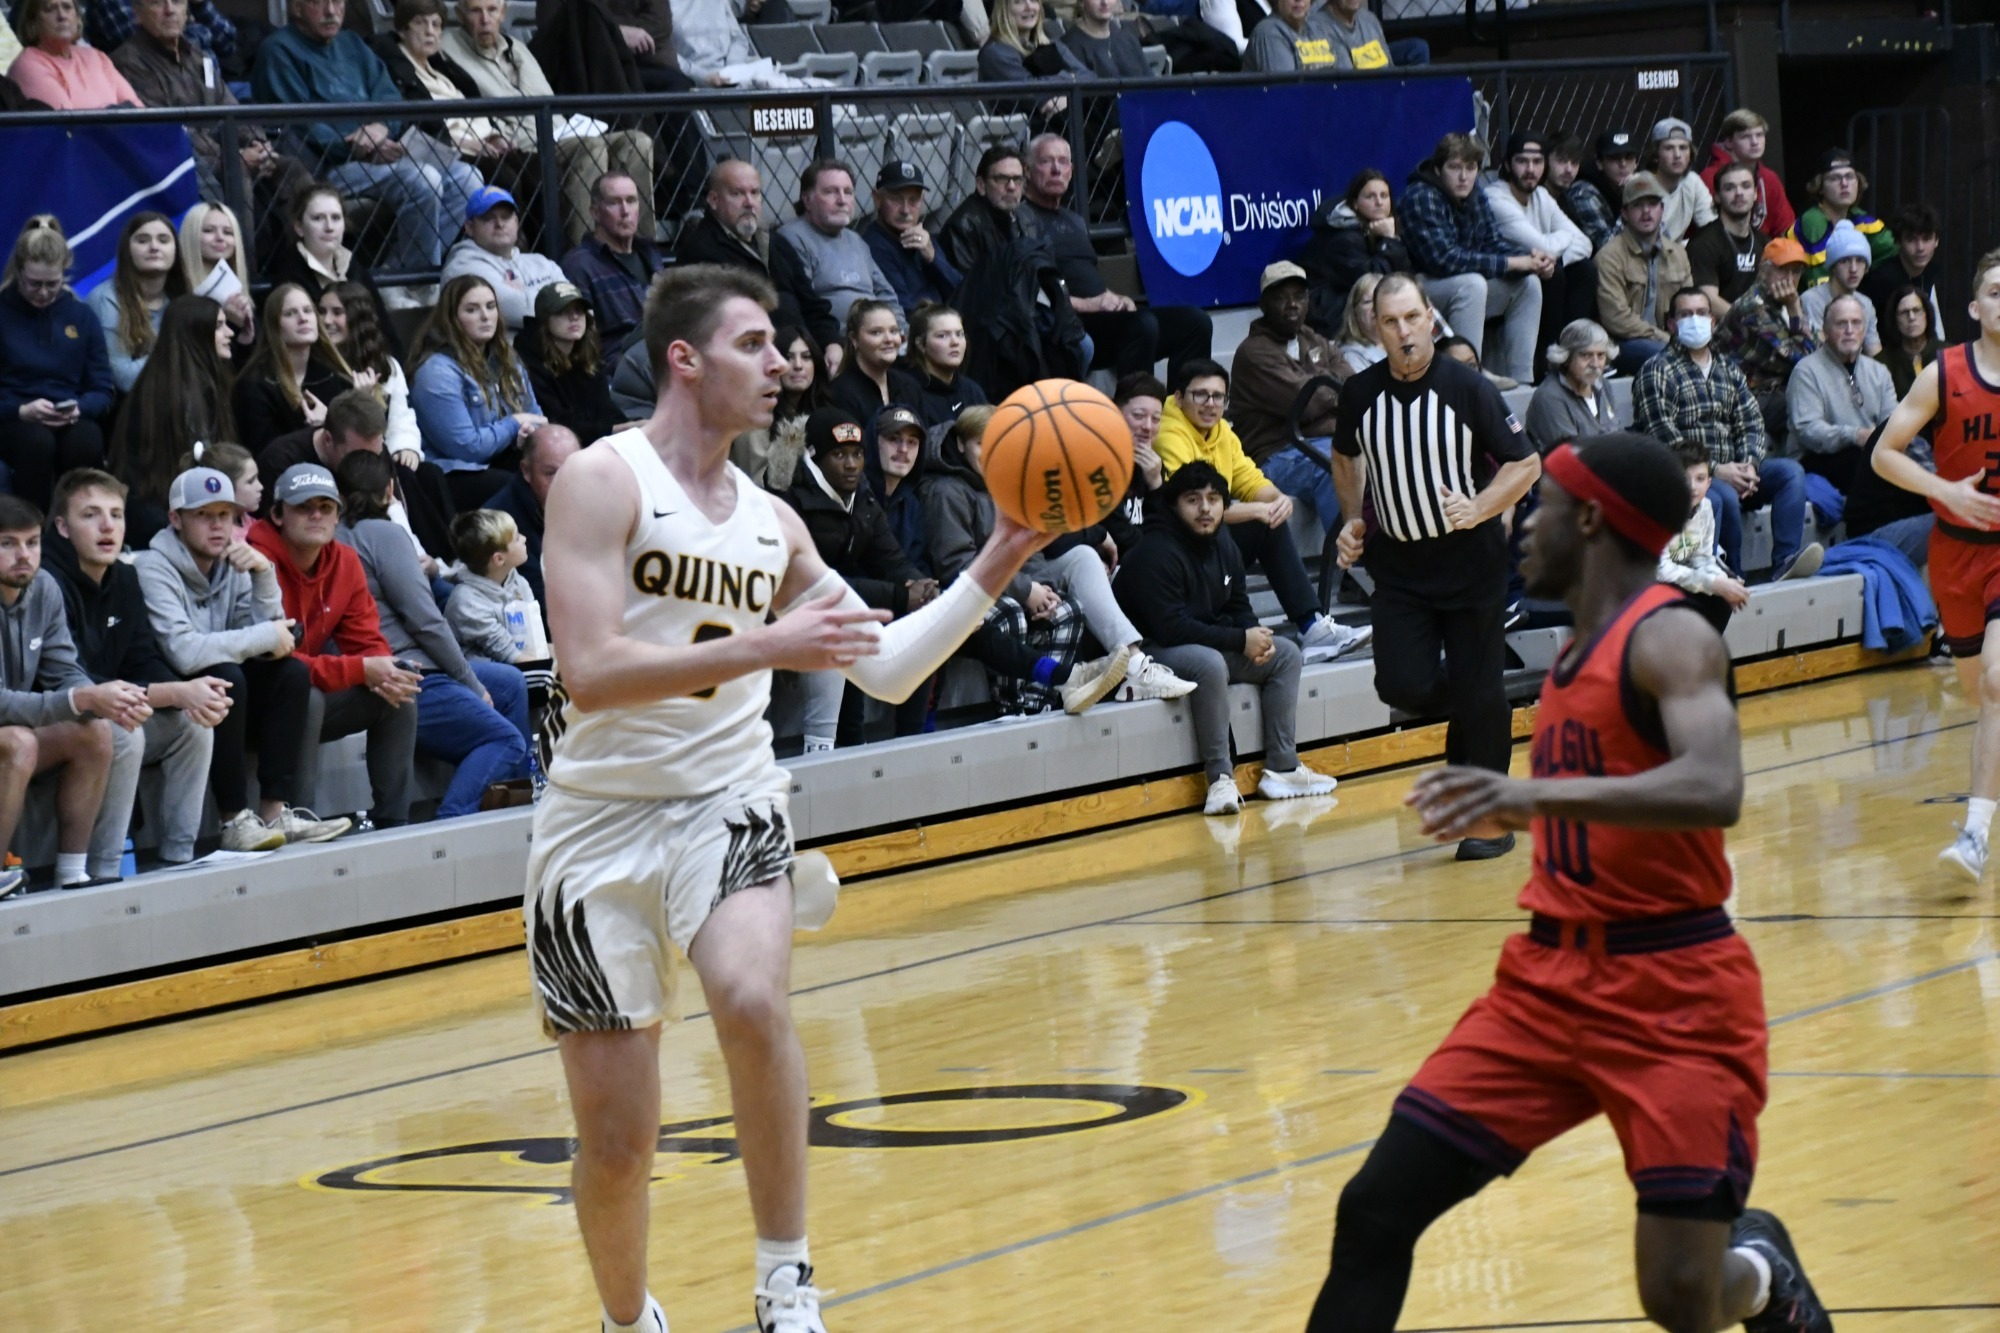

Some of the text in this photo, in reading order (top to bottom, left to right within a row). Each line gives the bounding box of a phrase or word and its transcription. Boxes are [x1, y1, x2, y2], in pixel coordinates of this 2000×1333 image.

[1638, 69, 1679, 90] RESERVED
[753, 107, 814, 131] RESERVED
[1154, 195, 1223, 238] NCAA
[1230, 191, 1309, 232] Division
[1963, 412, 2000, 443] HL
